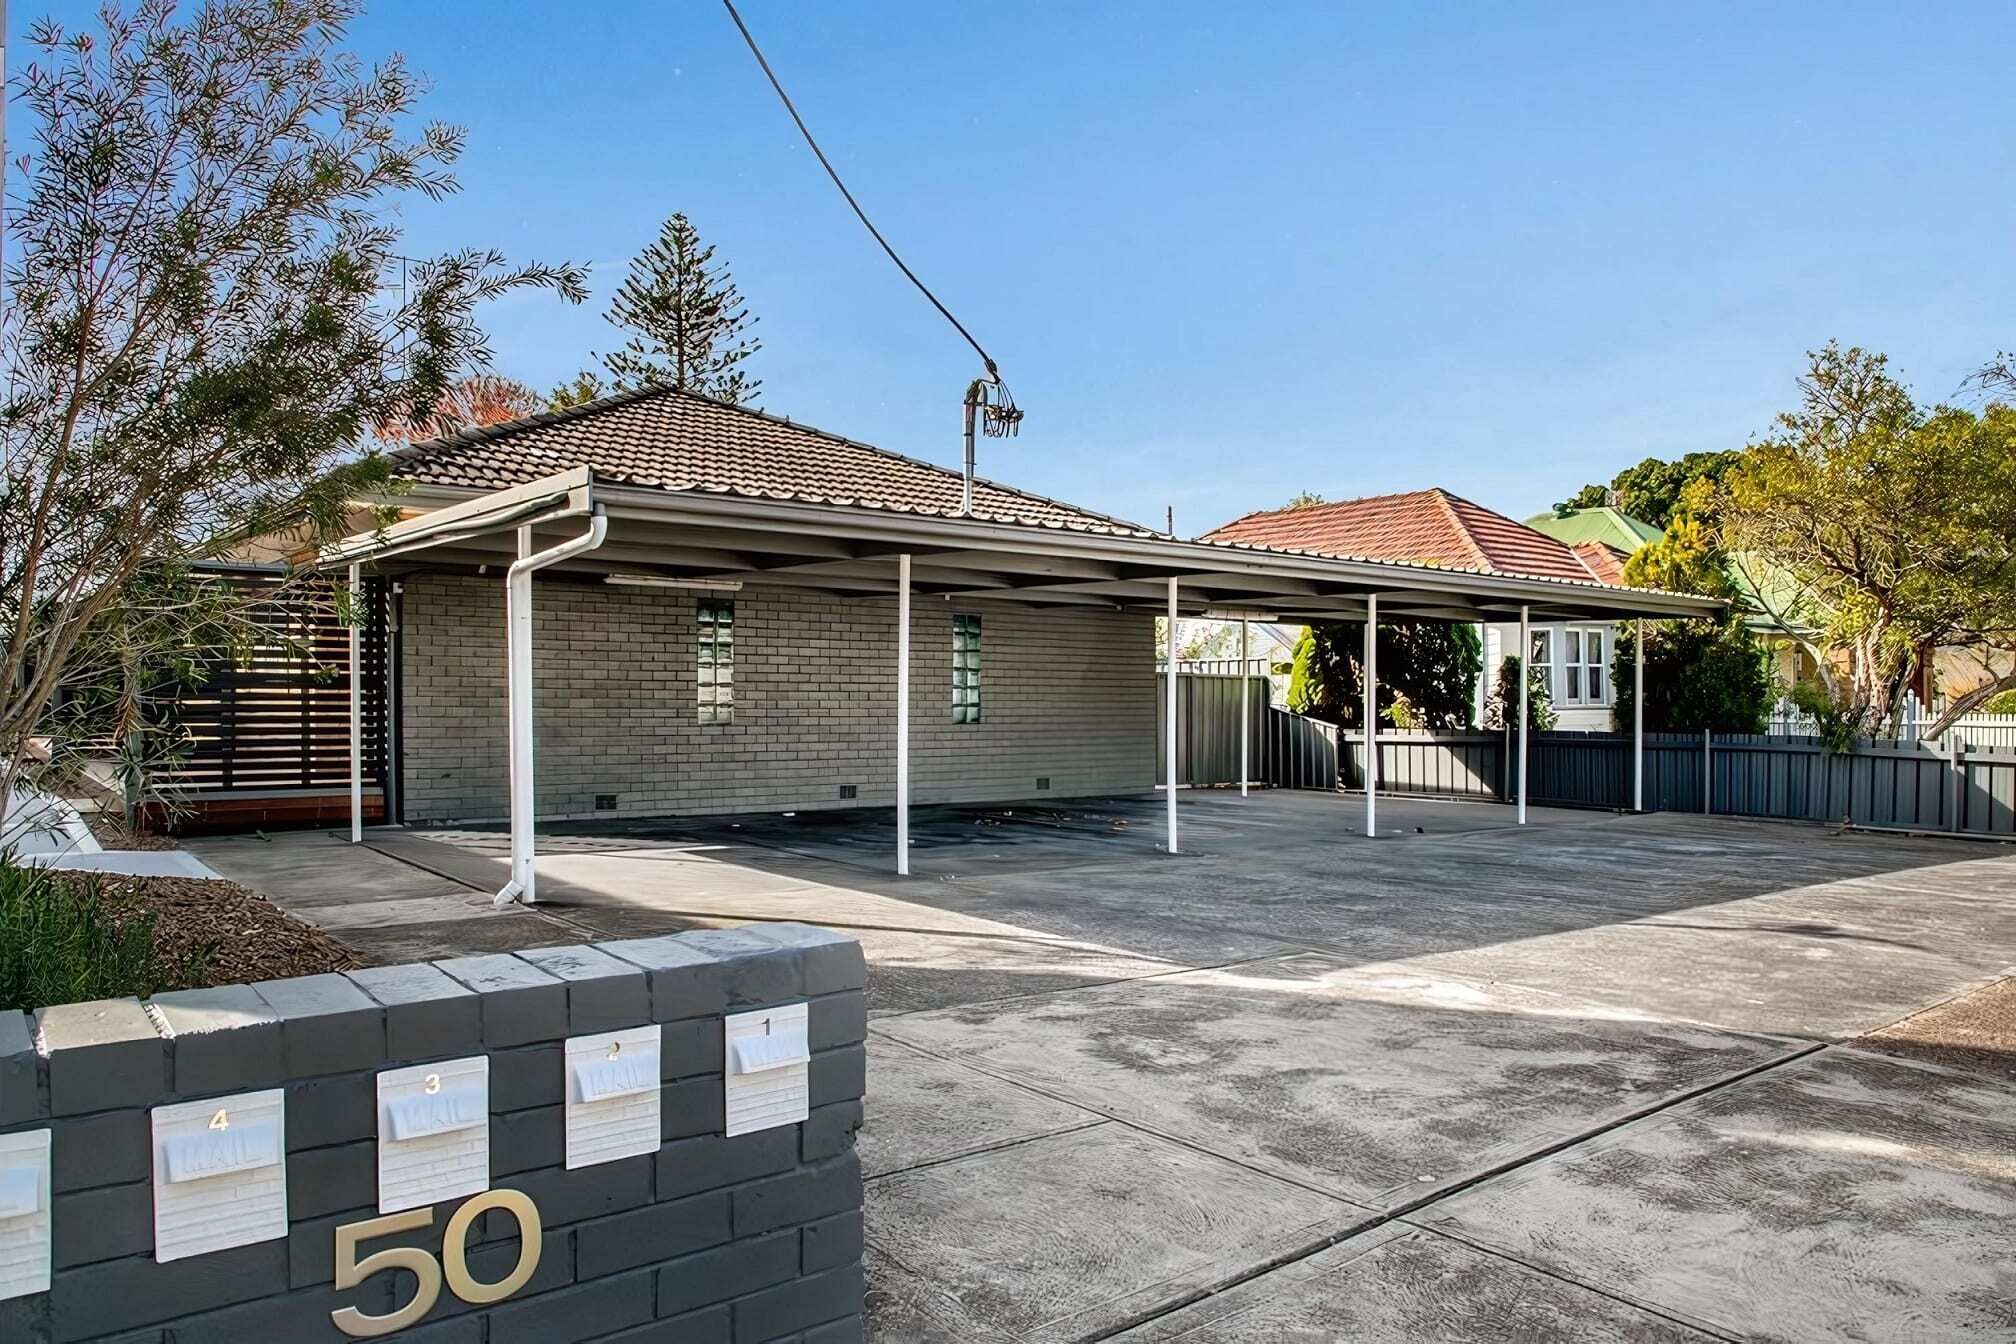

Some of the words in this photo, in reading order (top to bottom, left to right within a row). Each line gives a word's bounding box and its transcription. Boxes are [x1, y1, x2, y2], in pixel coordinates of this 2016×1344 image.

[761, 1017, 770, 1036] 1
[424, 1074, 441, 1095] 3
[208, 1108, 229, 1131] 4
[331, 1188, 543, 1337] 50
